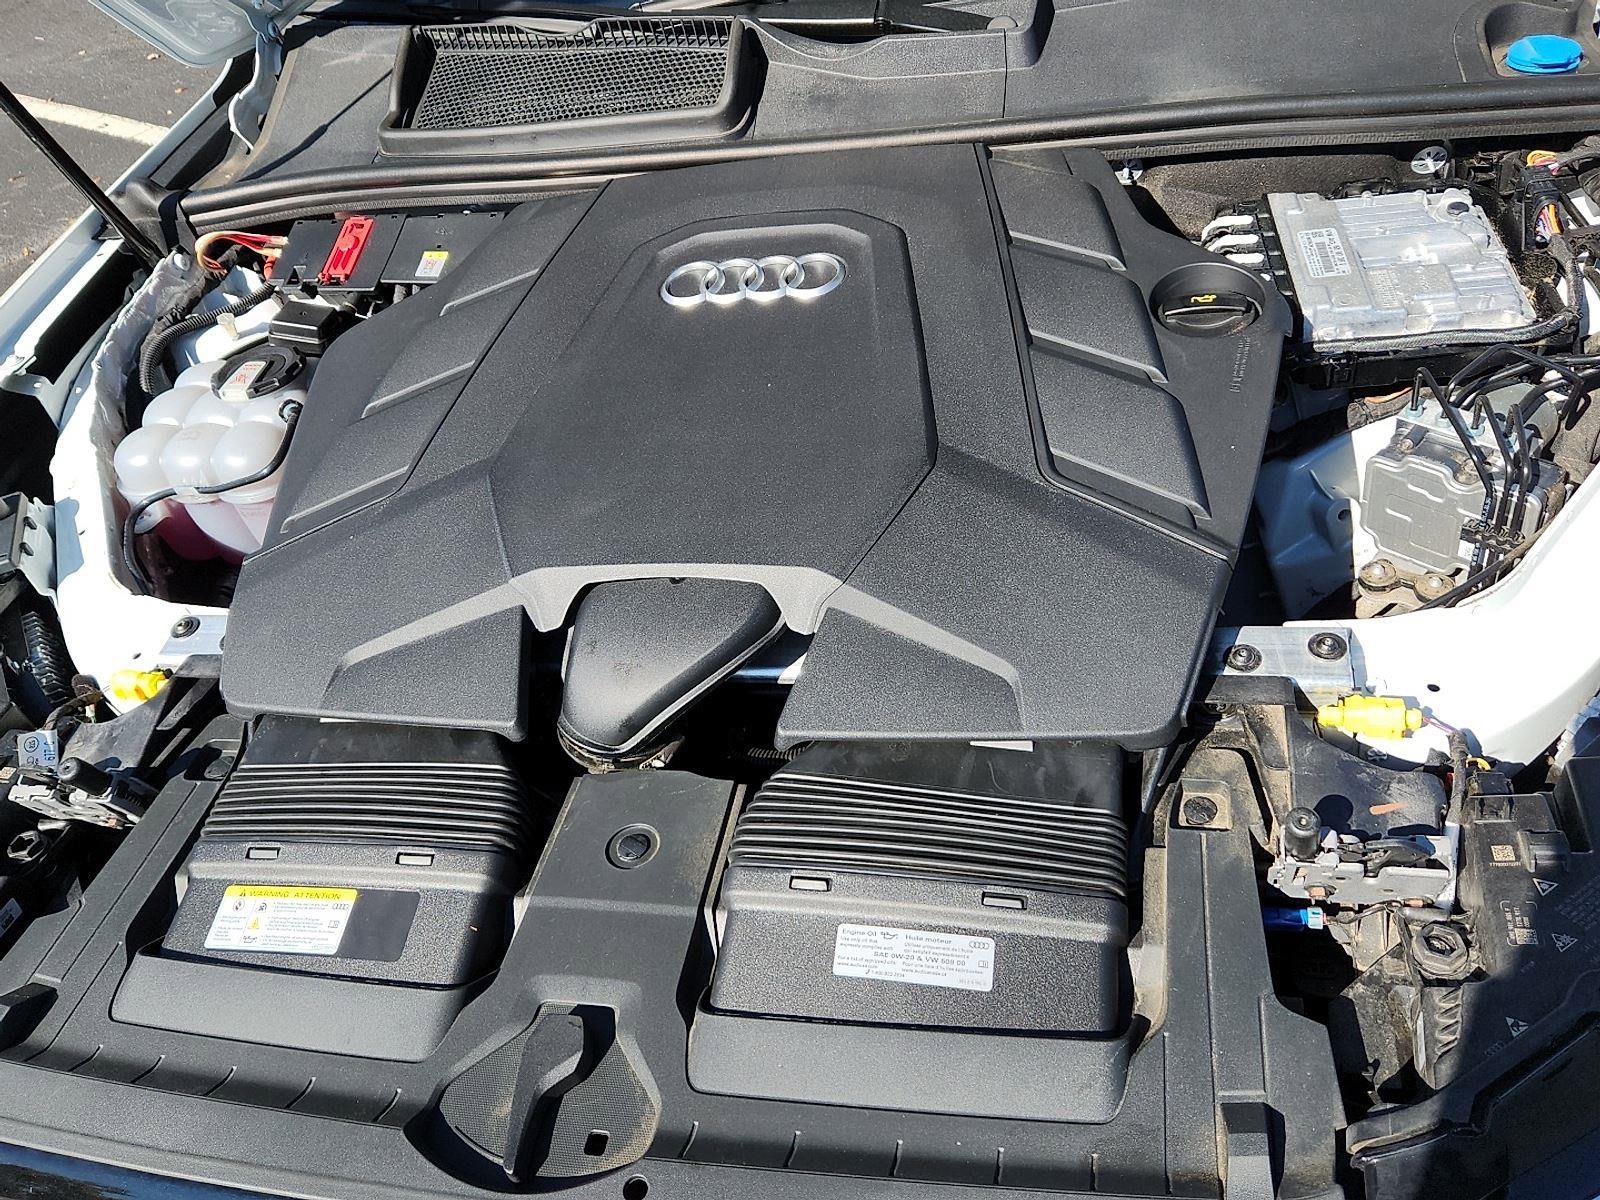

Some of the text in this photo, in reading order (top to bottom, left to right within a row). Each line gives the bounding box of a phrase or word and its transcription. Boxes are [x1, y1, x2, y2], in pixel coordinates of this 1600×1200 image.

[249, 890, 341, 900] WARNING ATTENTION
[842, 928, 865, 936] Engine
